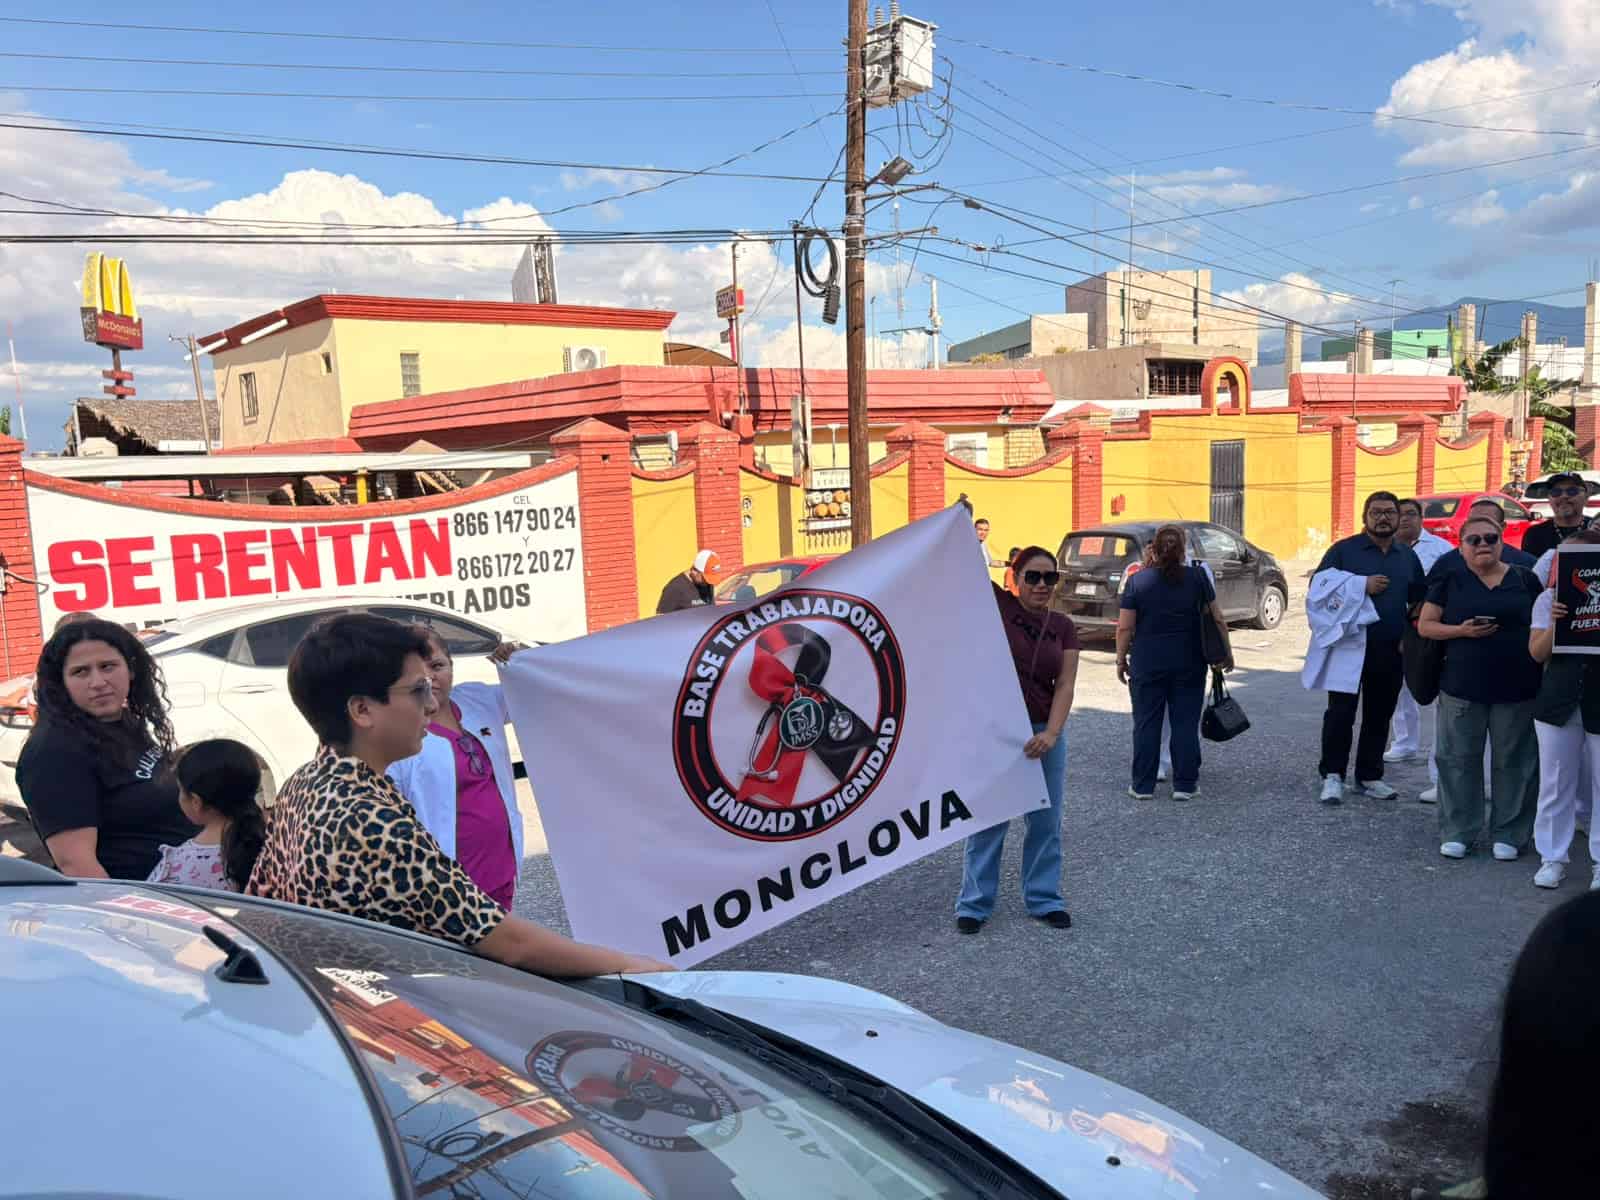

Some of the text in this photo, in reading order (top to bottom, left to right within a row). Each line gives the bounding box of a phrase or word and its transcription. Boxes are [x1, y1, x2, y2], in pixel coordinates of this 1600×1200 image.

[513, 496, 531, 505] CEL
[522, 536, 530, 547] Y
[47, 517, 452, 612] SE RENTAN
[683, 597, 886, 718] BASE TRABAJADORA
[707, 716, 896, 833] UNIDAD Y DIGNIDAD
[790, 726, 818, 745] IMSS
[661, 789, 973, 957] MONCLOVA
